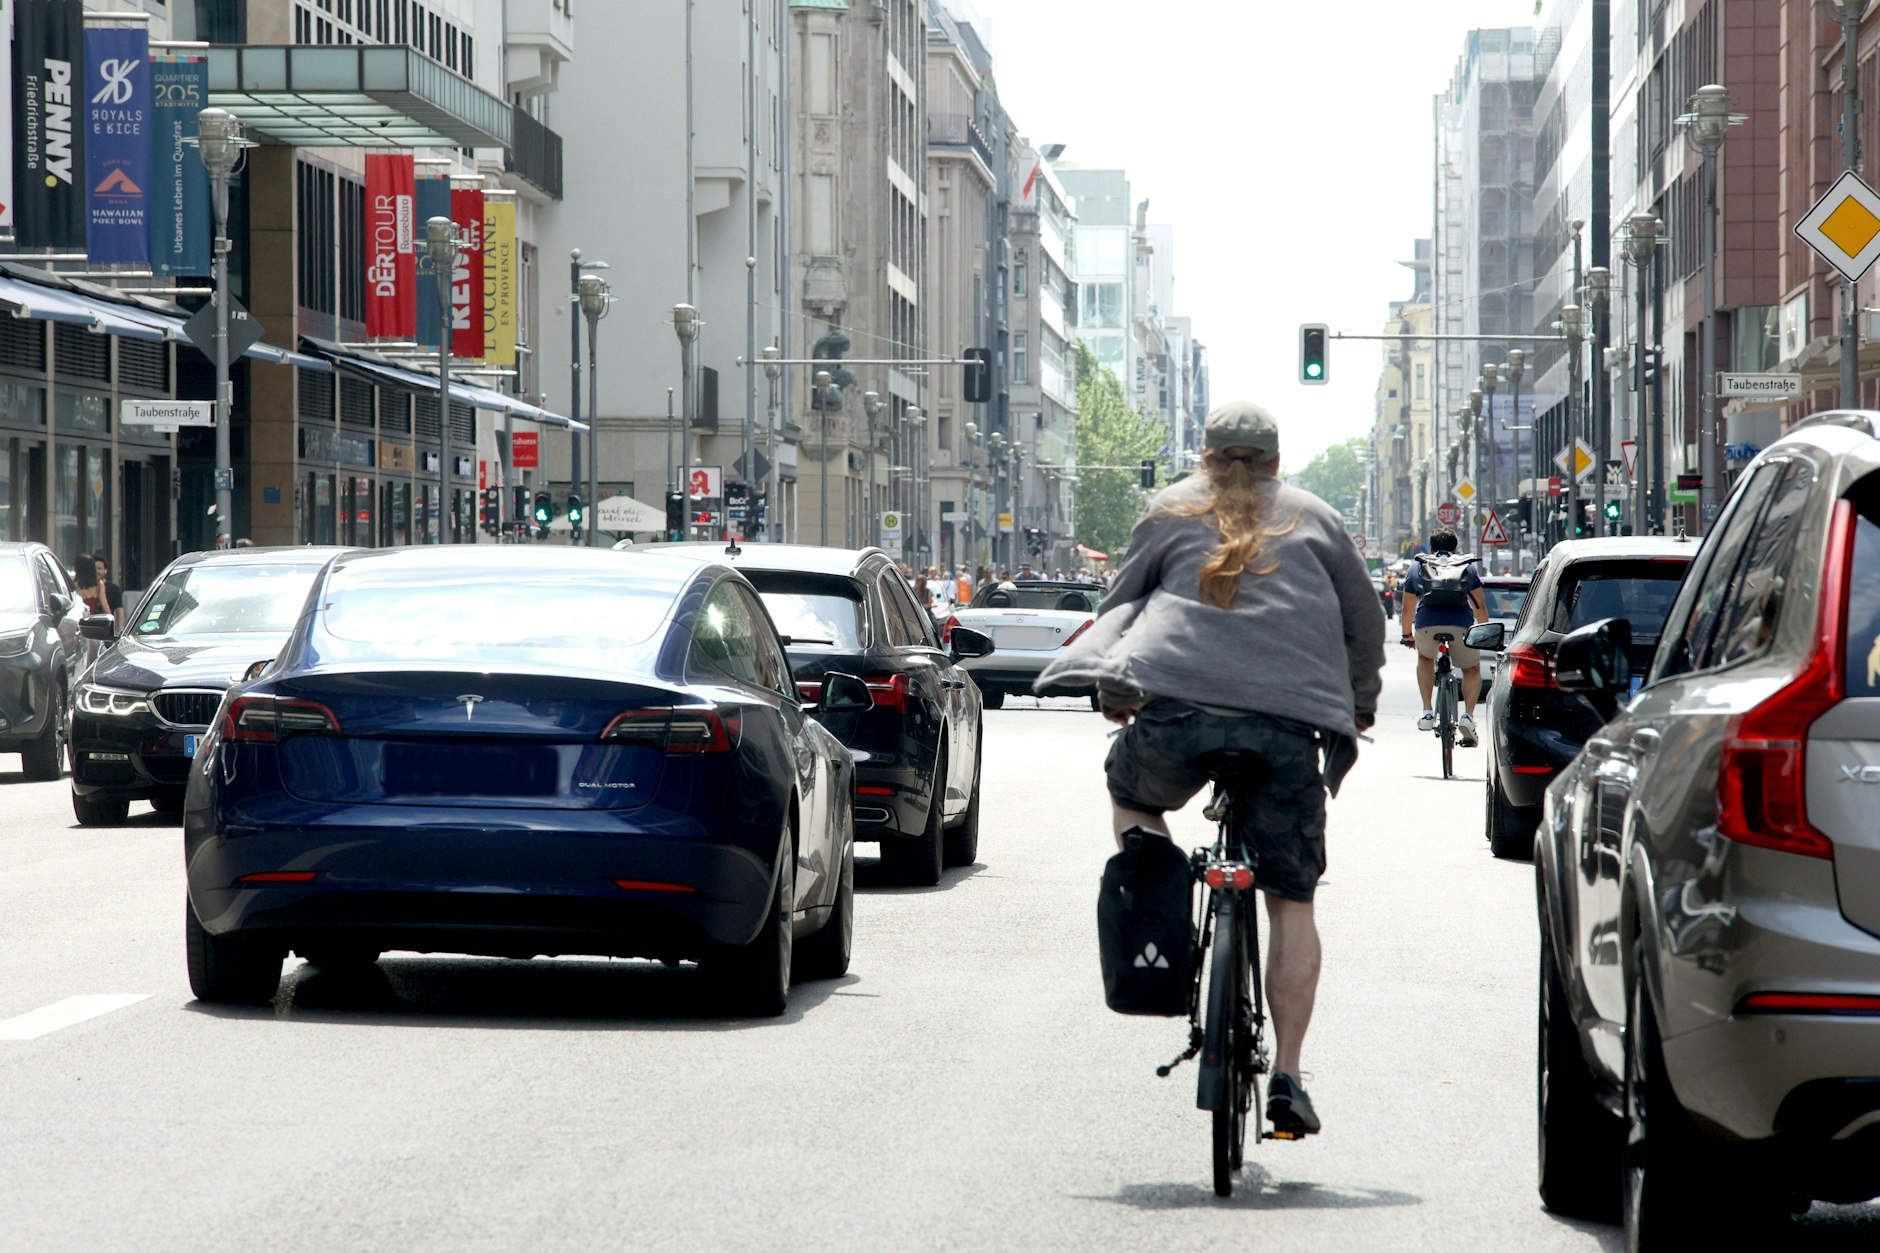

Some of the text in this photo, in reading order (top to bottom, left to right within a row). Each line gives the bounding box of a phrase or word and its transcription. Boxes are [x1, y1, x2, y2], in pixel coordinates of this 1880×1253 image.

[155, 74, 199, 83] QUARTIER
[155, 84, 200, 100] 205
[27, 75, 39, 169] Friedrichstraße
[173, 120, 184, 254] Urbanes Leben im Quadrat
[93, 209, 144, 217] HAWAIIAN
[400, 198, 410, 251] Reisebüro
[376, 194, 395, 297] DERTOUR
[470, 218, 480, 251] CITY
[500, 242, 509, 326] EN PROVENCE
[1136, 357, 1145, 381] MUR
[1136, 384, 1145, 394] LE
[1727, 378, 1796, 391] Taubenstraße
[134, 406, 200, 420] Taubenstraße
